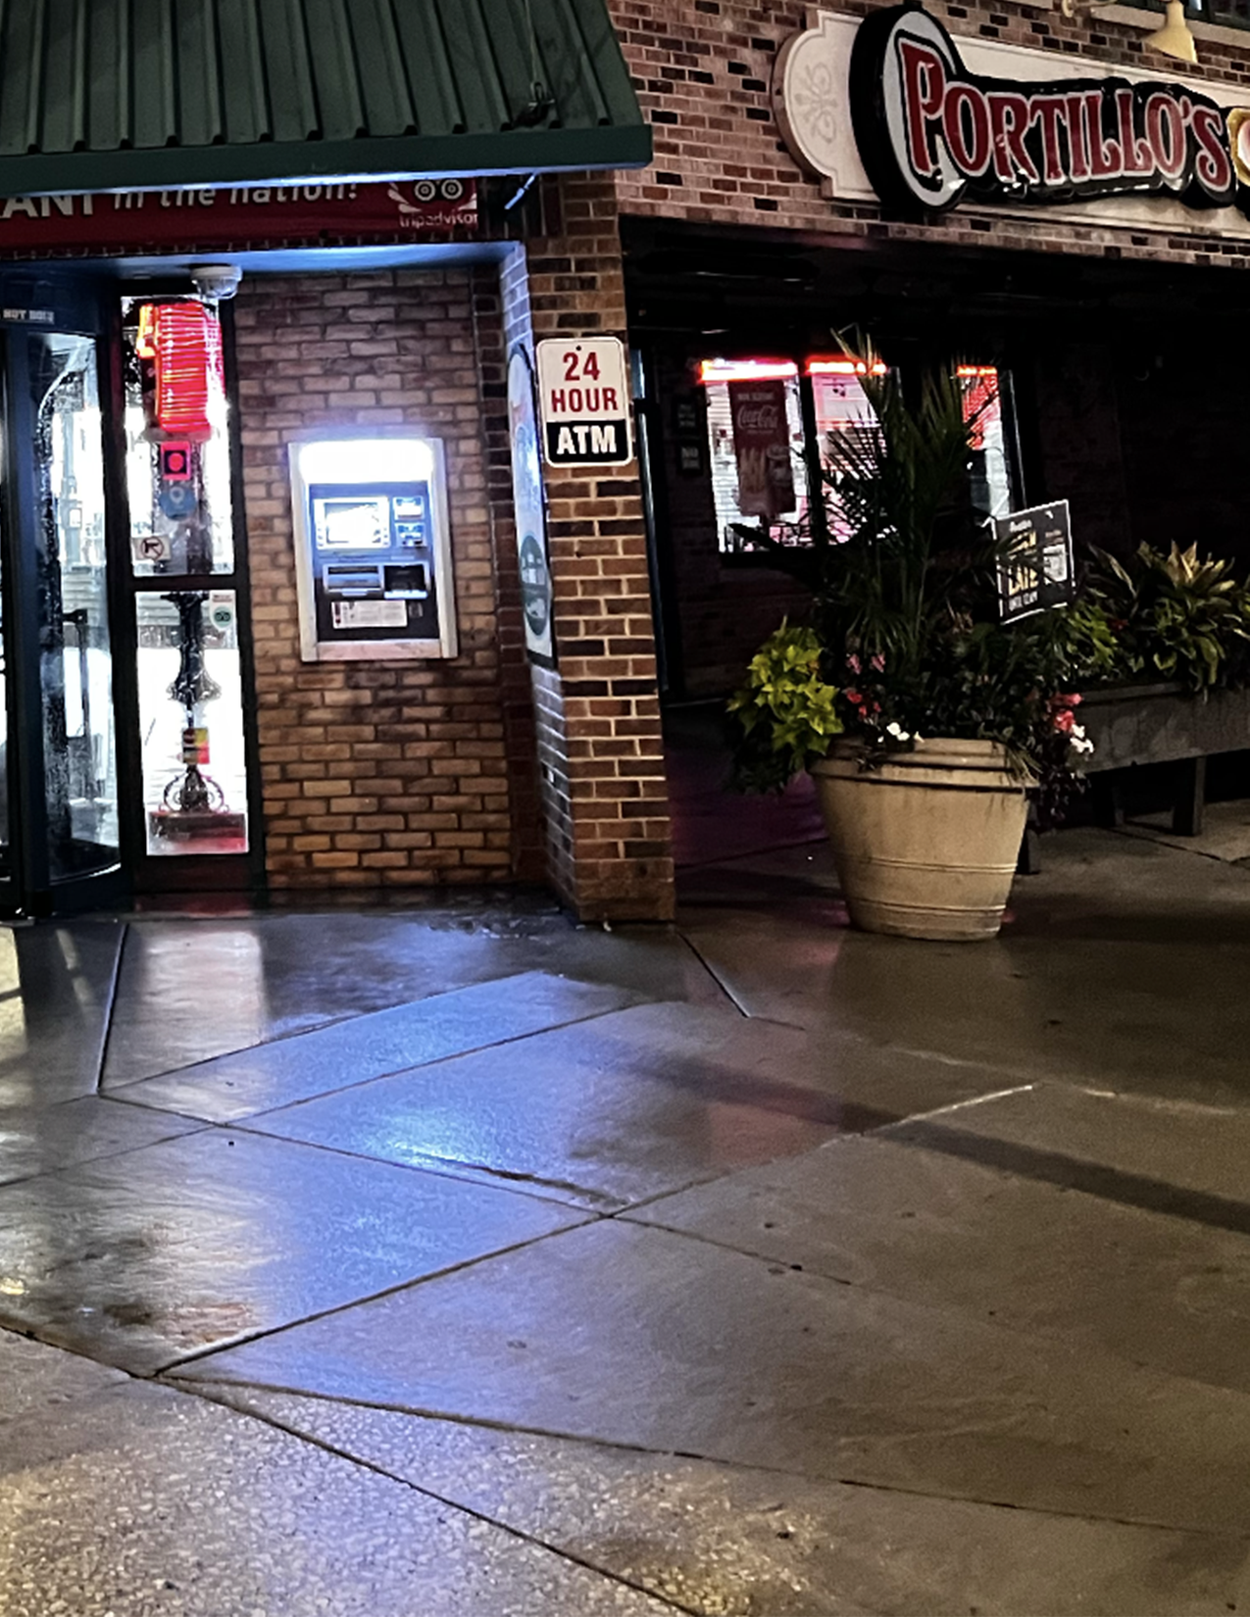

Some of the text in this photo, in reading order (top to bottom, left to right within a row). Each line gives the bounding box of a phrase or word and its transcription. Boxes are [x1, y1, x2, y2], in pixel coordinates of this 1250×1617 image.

[899, 39, 1232, 191] PORTILLO'S
[400, 209, 479, 229] tripadvisor
[562, 351, 601, 381] 24
[551, 387, 618, 413] HOUR
[556, 425, 617, 455] ATM
